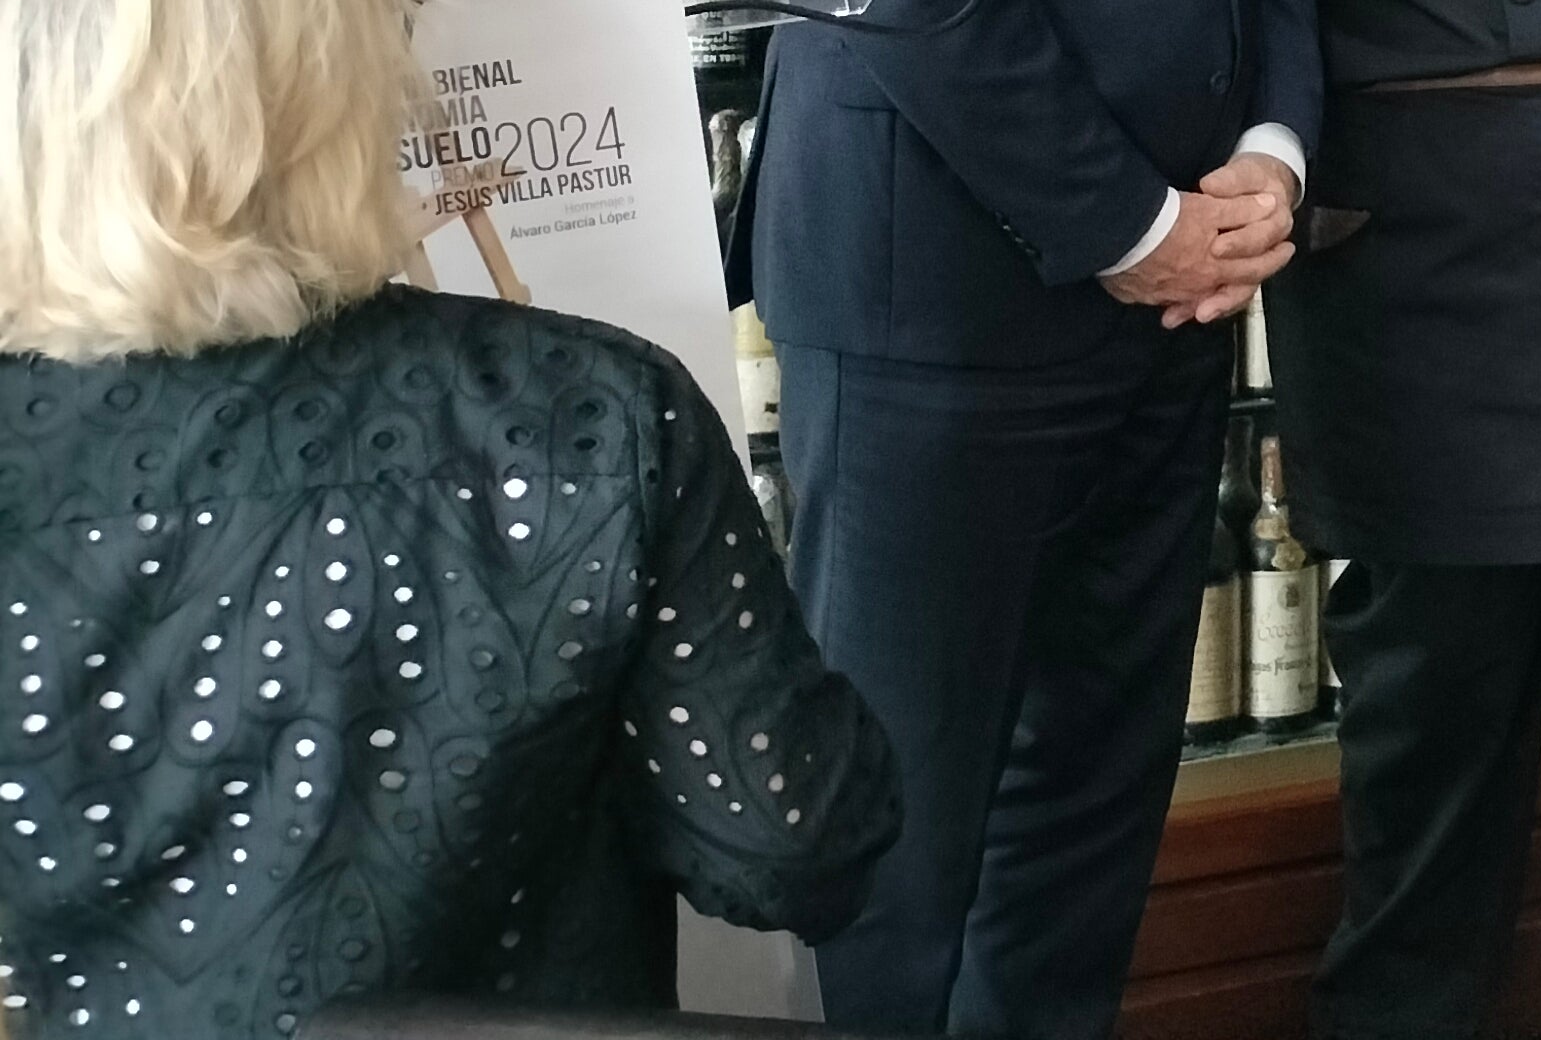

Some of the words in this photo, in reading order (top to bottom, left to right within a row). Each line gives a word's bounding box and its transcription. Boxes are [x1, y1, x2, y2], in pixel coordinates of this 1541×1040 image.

[433, 59, 522, 96] BIENAL
[494, 106, 626, 178] 2024
[431, 161, 495, 191] PREMIO
[496, 177, 553, 205] VILLA
[557, 164, 632, 196] PASTUR
[564, 196, 625, 215] Homenaje
[510, 224, 551, 240] Álvaro
[599, 209, 637, 226] López
